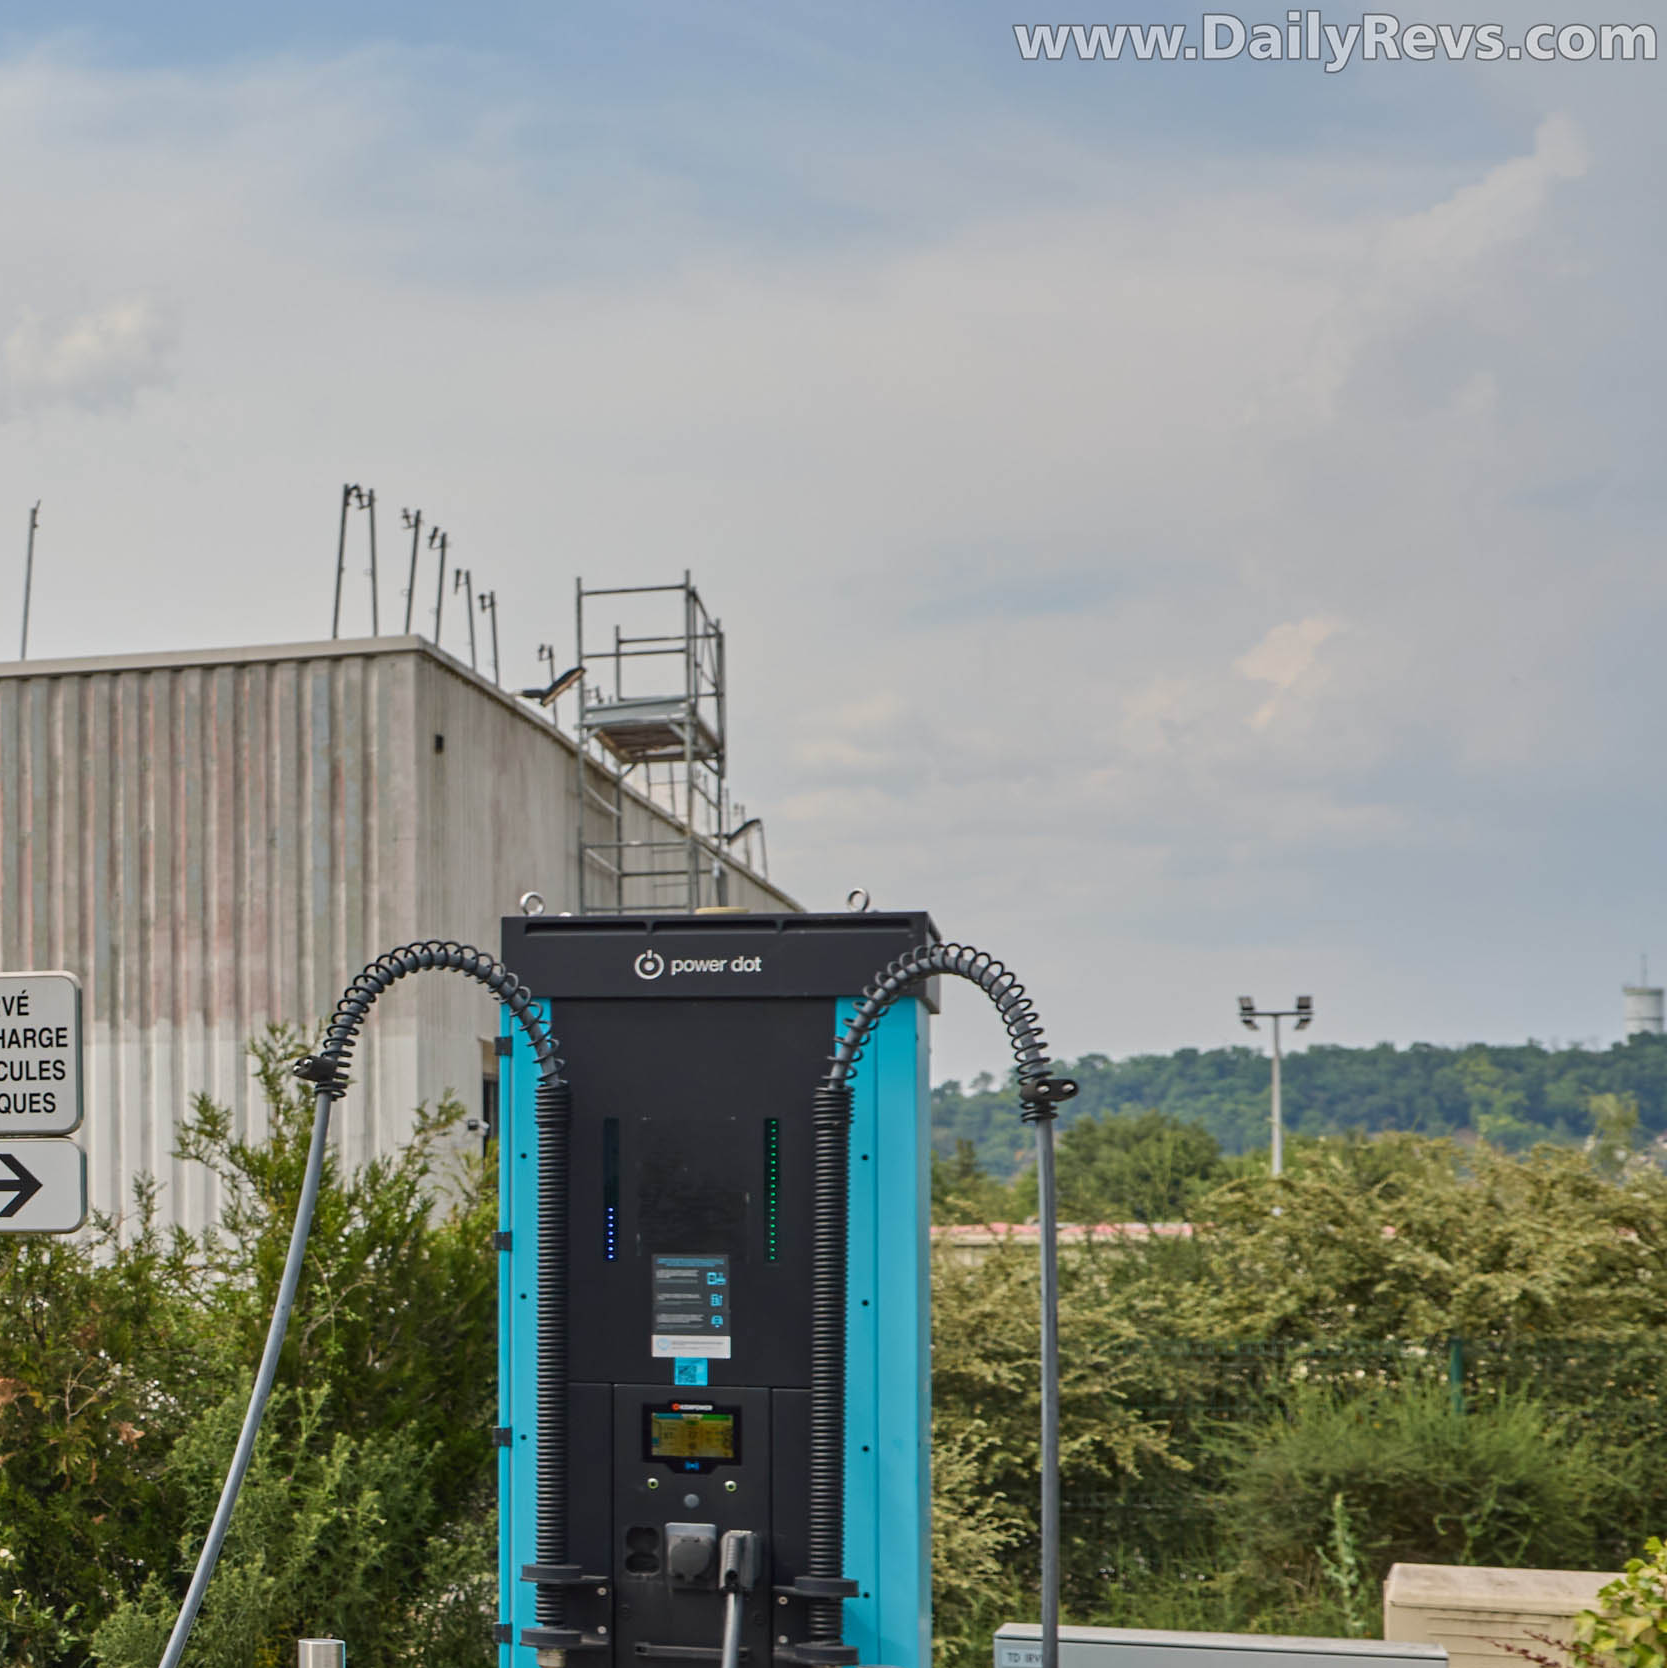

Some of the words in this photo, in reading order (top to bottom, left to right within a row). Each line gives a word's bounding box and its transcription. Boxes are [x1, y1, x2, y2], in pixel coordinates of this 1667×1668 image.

[671, 959, 727, 976] power
[731, 956, 762, 972] dot
[1026, 1653, 1044, 1663] IRV
